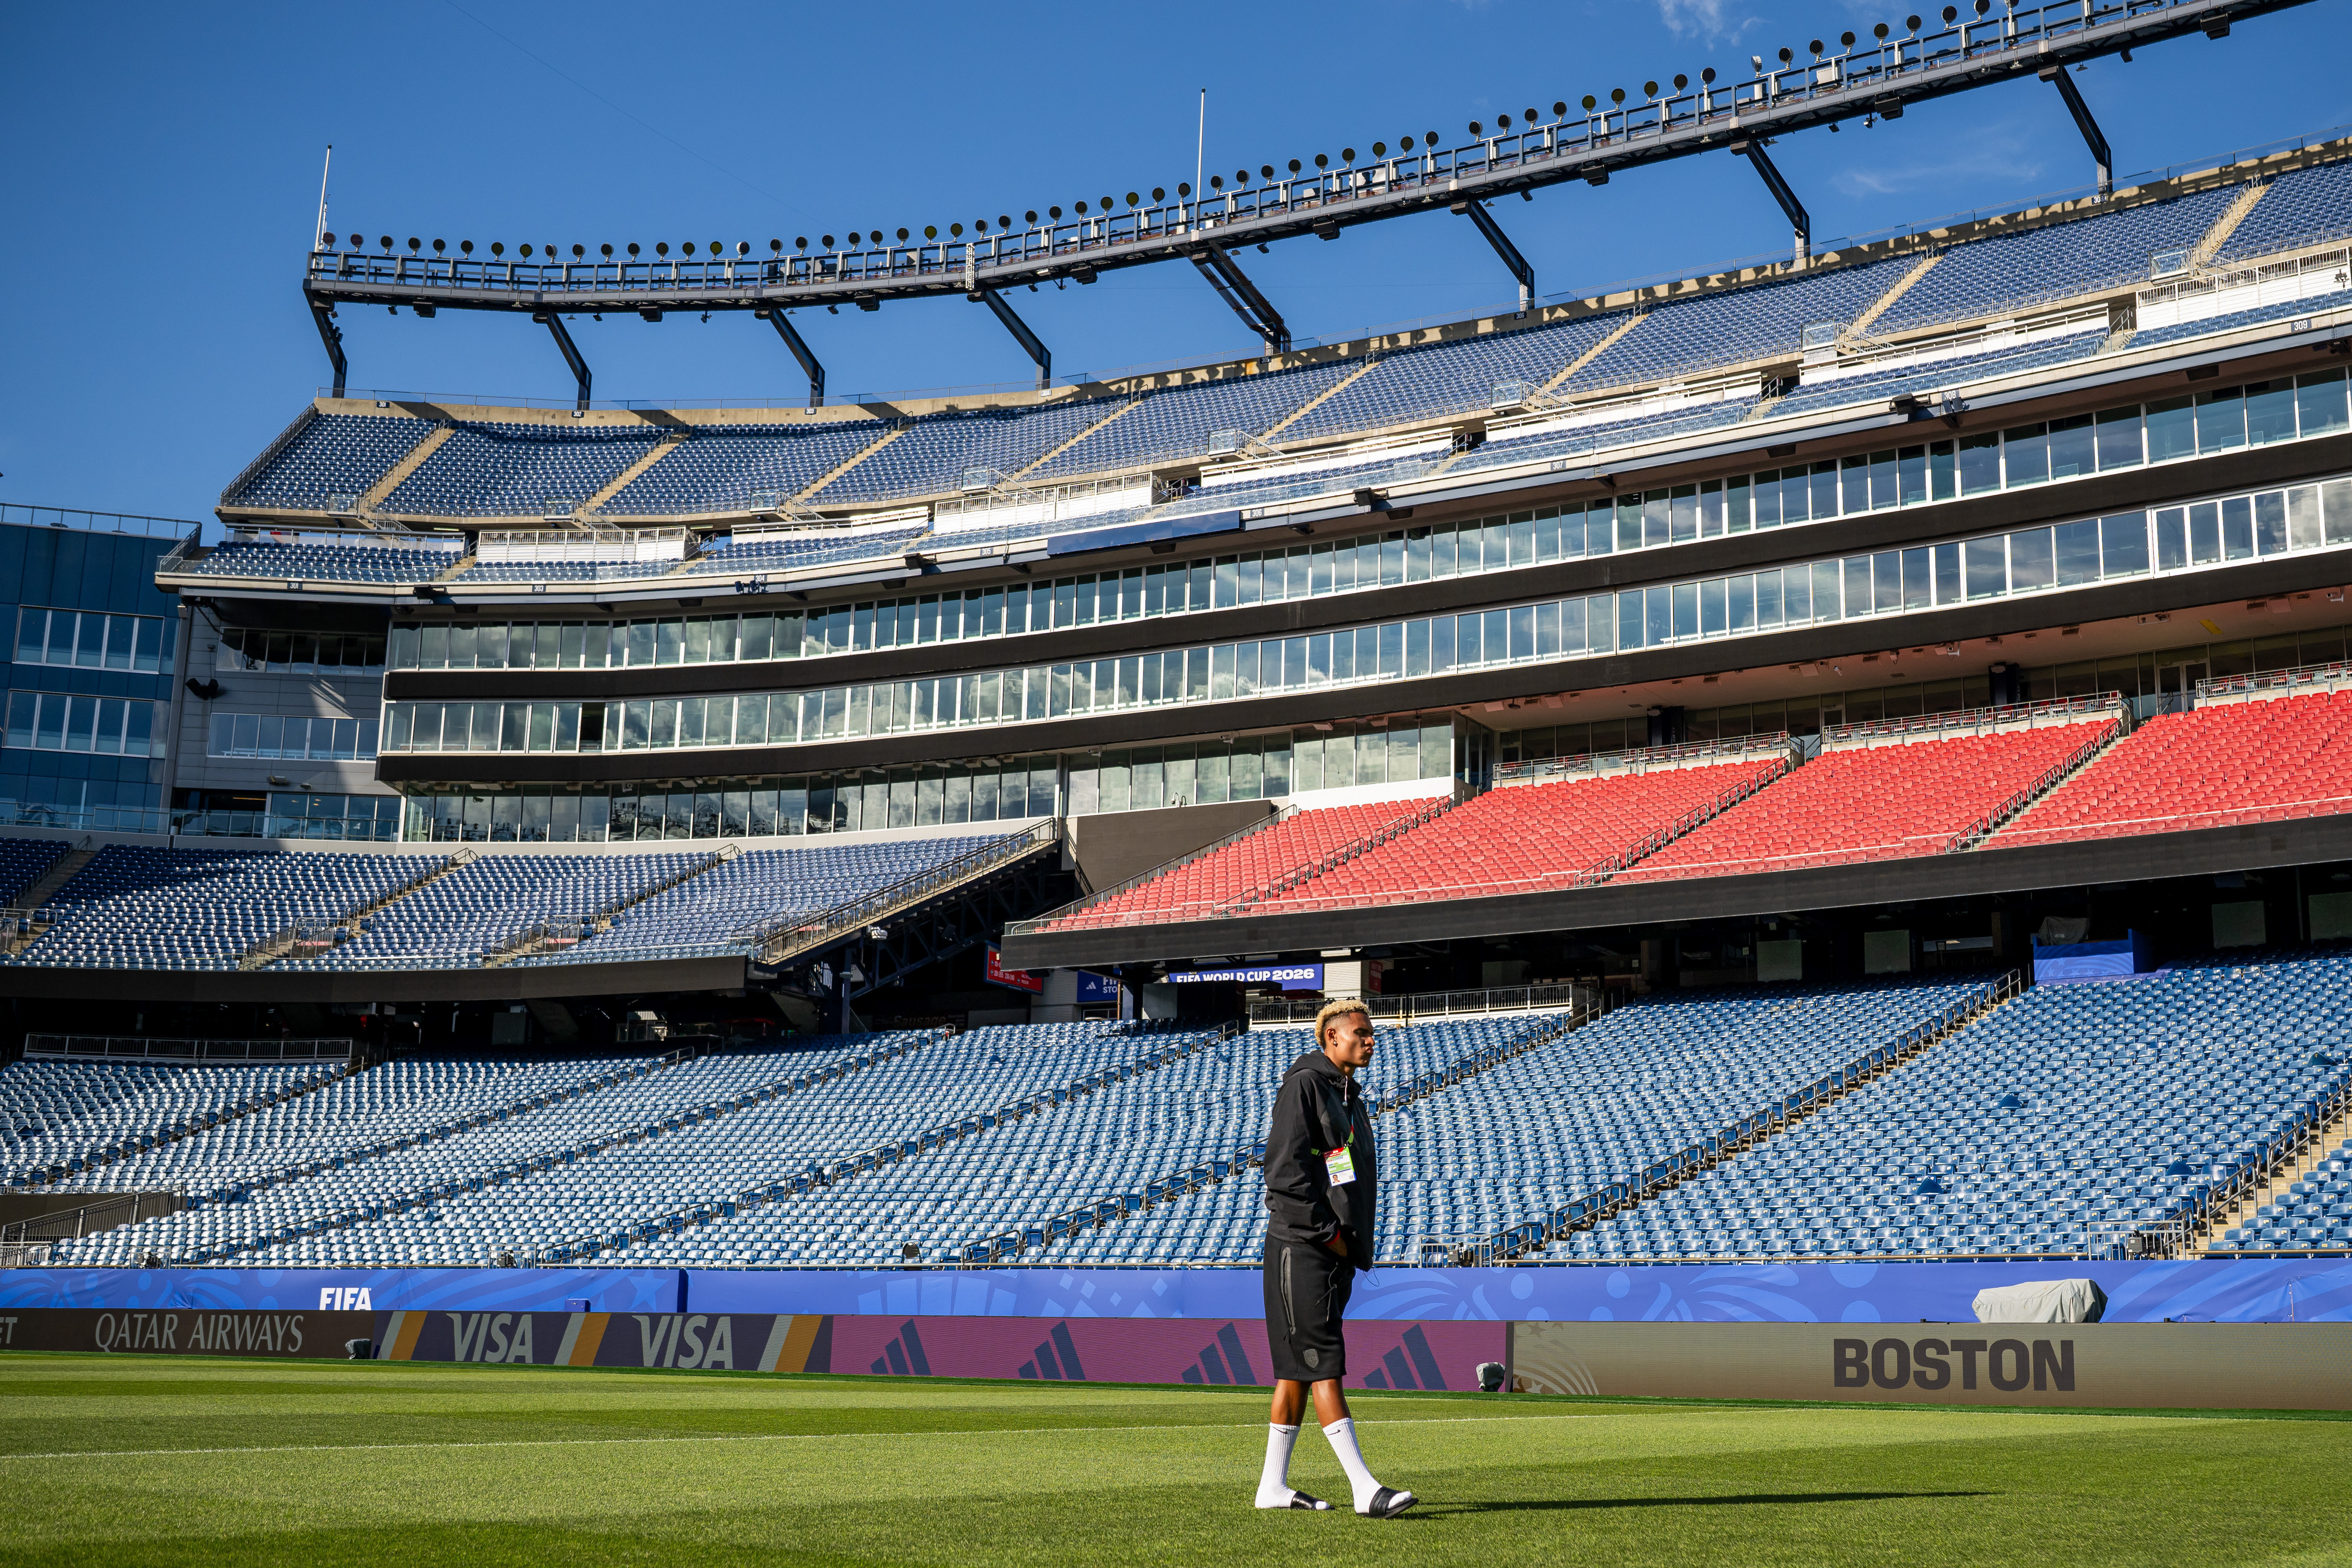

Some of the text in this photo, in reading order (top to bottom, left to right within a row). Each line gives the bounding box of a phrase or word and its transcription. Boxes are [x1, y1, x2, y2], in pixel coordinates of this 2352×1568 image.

[2094, 195, 2103, 204] 308
[2294, 319, 2308, 331] 309
[1944, 390, 1956, 400] 308
[1553, 461, 1563, 470] 307
[1203, 973, 1245, 982] WORLD
[1247, 971, 1271, 982] CUP
[1272, 969, 1315, 980] 2026
[319, 1287, 372, 1310] FIFA
[96, 1313, 304, 1352] QATAR AIRWAYS
[446, 1313, 533, 1364] VISA
[632, 1315, 733, 1370] VISA
[1834, 1338, 2075, 1392] BOSTON
